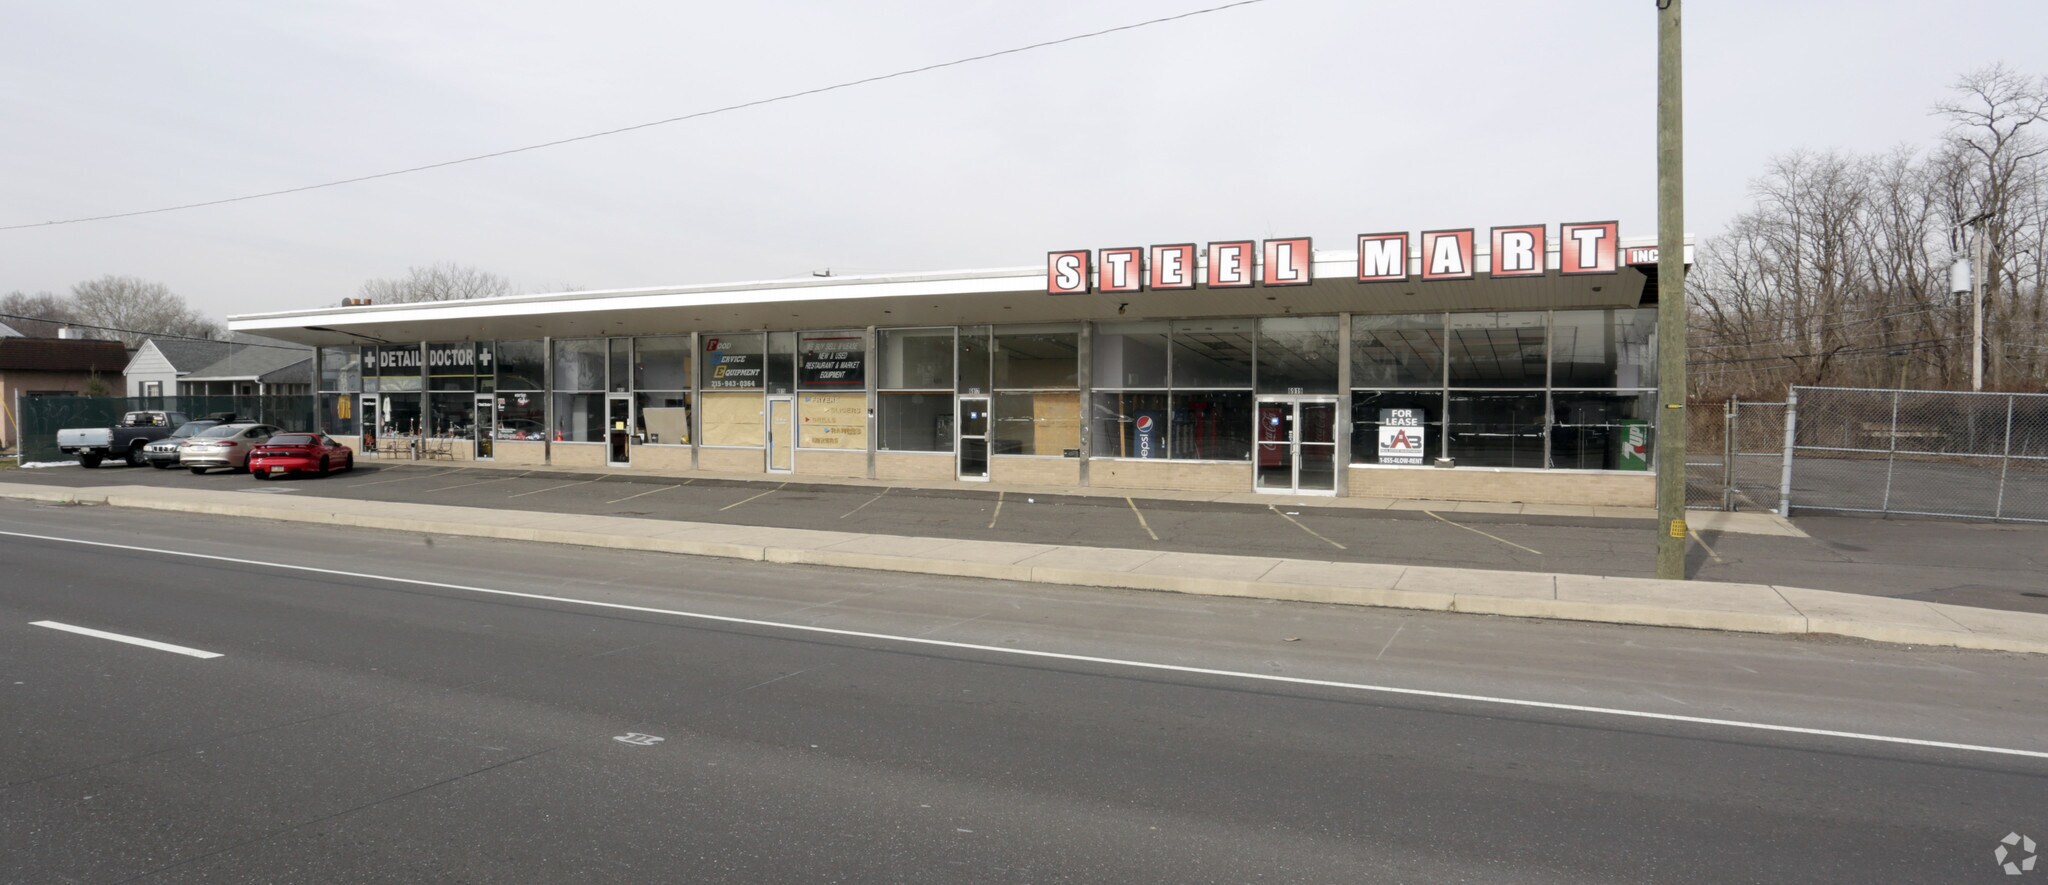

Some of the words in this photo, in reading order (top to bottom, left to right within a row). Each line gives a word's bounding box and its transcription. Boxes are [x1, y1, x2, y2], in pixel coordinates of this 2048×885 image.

[1055, 242, 1299, 290] STEEL
[1362, 226, 1606, 277] MART
[707, 339, 731, 351] FOOD
[380, 350, 422, 367] DETAIL
[429, 349, 474, 366] DOCTOR
[818, 352, 829, 360] NEW
[835, 352, 848, 360] USED
[805, 361, 835, 370] RESTAURANT
[835, 361, 840, 369] &
[840, 361, 860, 369] MARKET
[714, 365, 761, 378] EQUIPMENT
[820, 371, 846, 379] EQUIPMENT
[1392, 409, 1413, 418] FOR
[1385, 417, 1419, 426] LEASE
[1380, 428, 1422, 449] JAB
